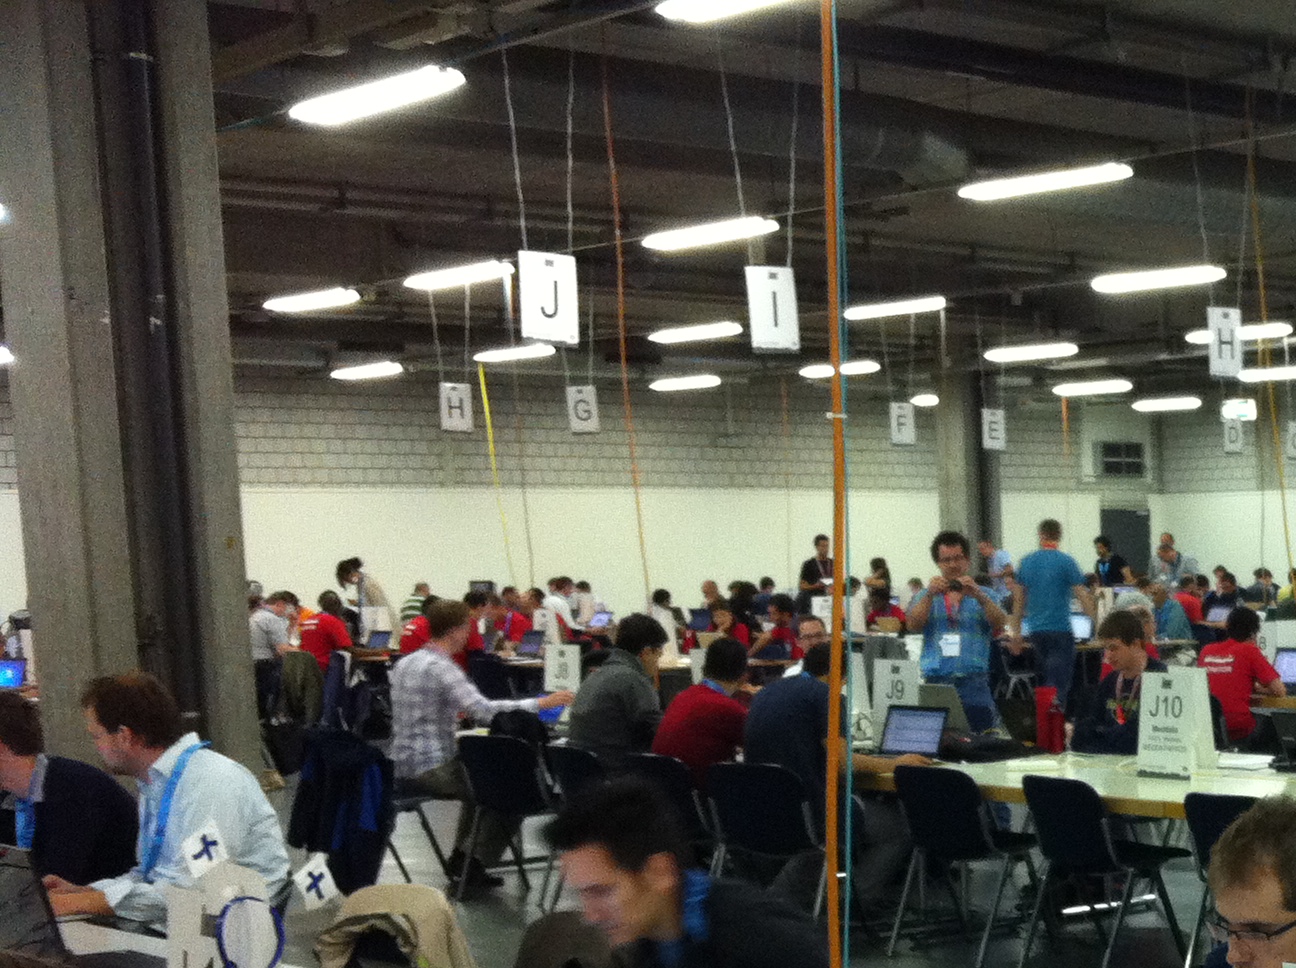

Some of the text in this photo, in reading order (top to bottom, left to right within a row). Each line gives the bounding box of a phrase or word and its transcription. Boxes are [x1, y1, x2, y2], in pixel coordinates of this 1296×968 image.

[540, 280, 558, 319] J
[771, 291, 778, 328] I
[1217, 328, 1235, 360] H
[446, 396, 465, 419] H
[573, 399, 593, 421] G
[896, 414, 908, 433] F
[988, 420, 1001, 440] E
[886, 679, 905, 701] J9
[1148, 695, 1183, 718] J10
